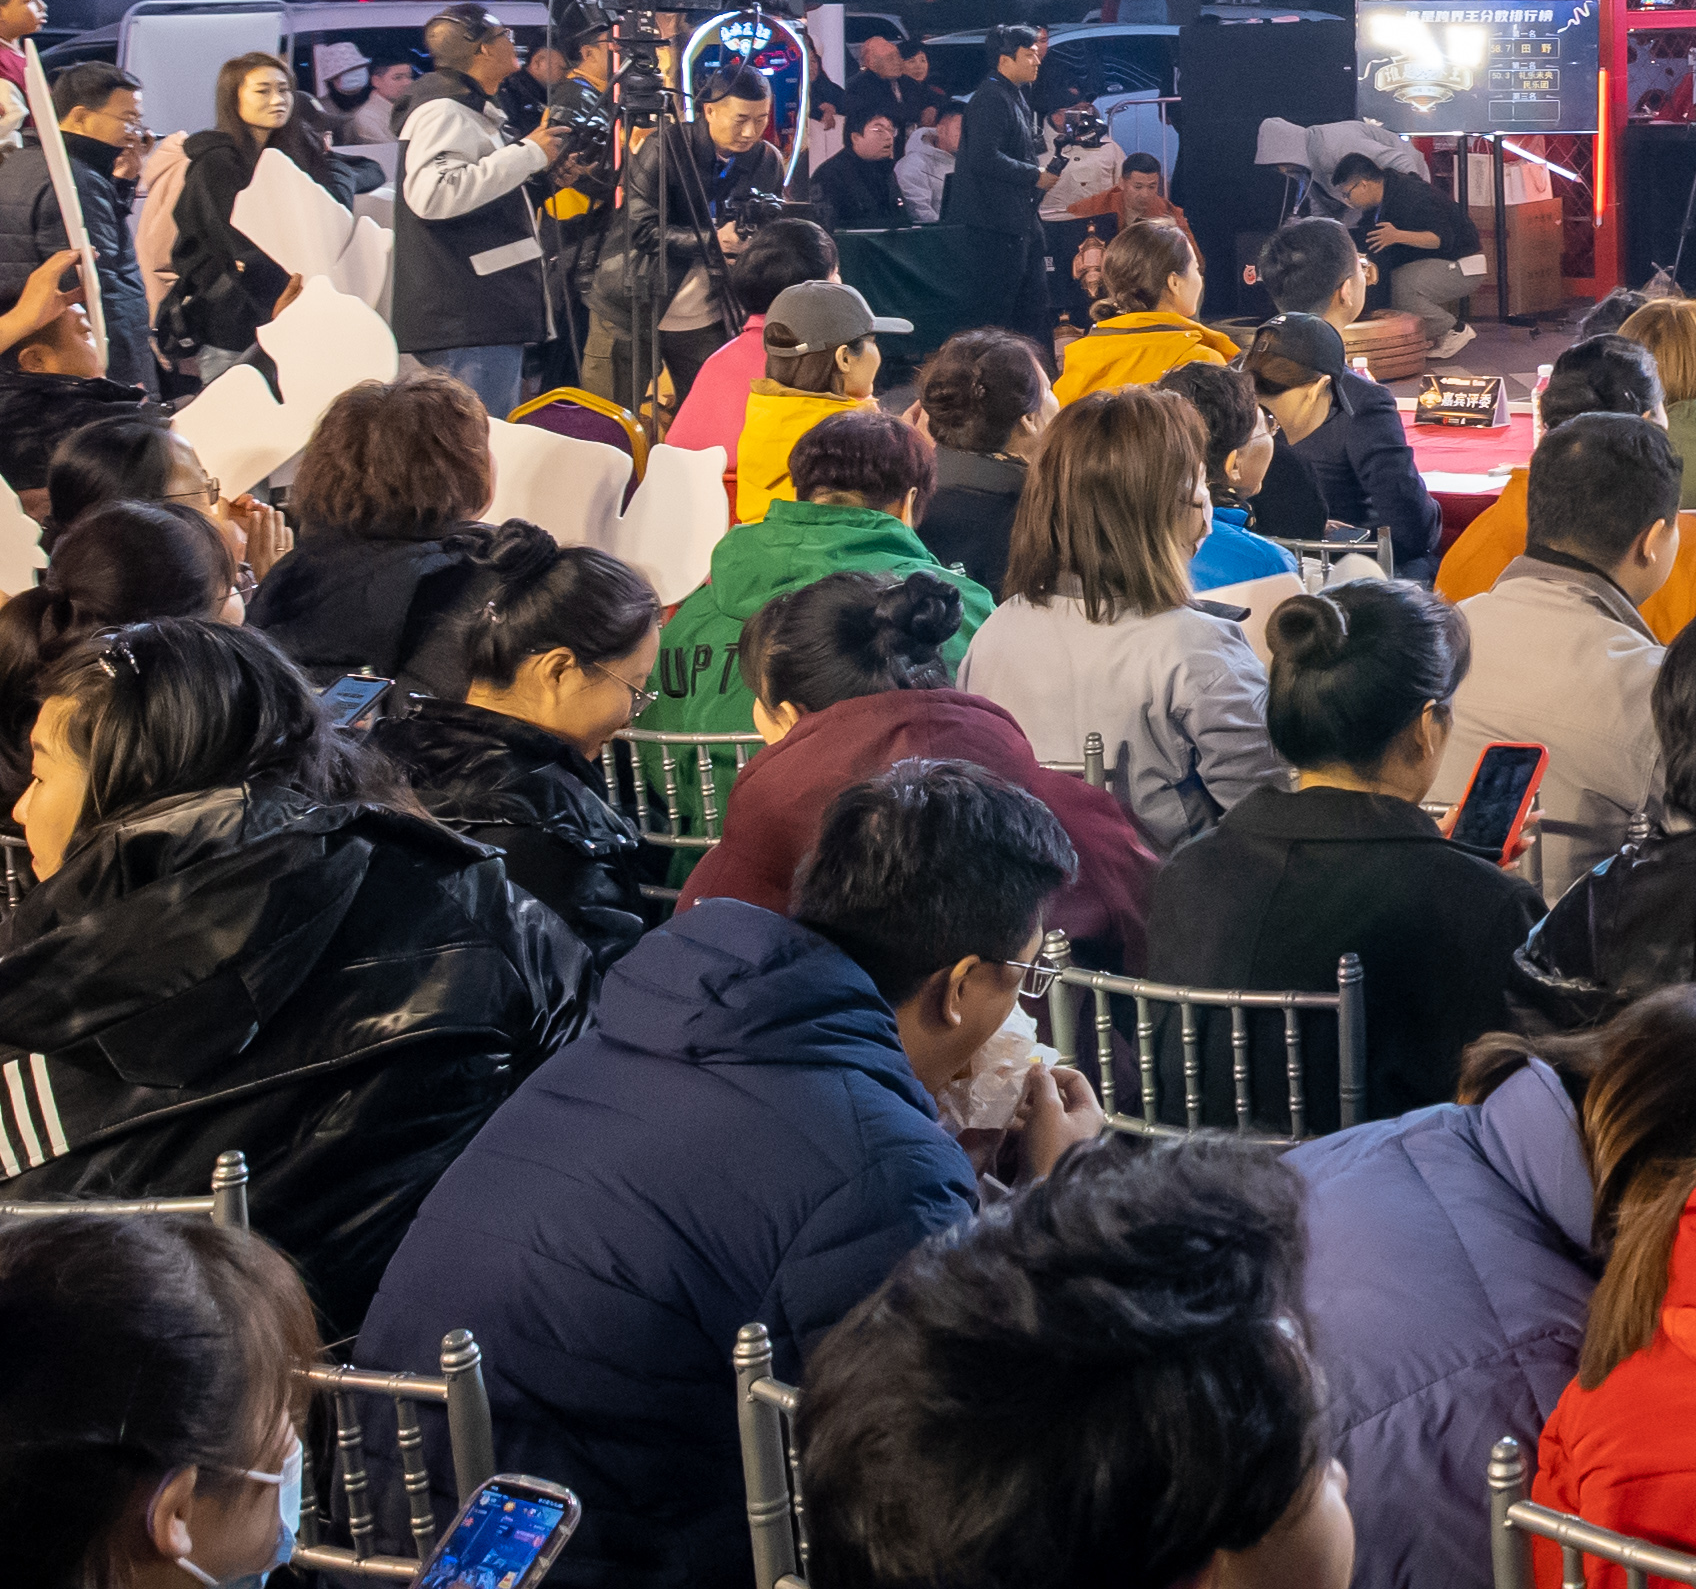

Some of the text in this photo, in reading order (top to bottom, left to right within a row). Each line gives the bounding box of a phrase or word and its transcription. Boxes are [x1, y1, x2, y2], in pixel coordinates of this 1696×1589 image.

[1512, 62, 1537, 70] 第二名
[1441, 392, 1492, 409] 嘉宾评委
